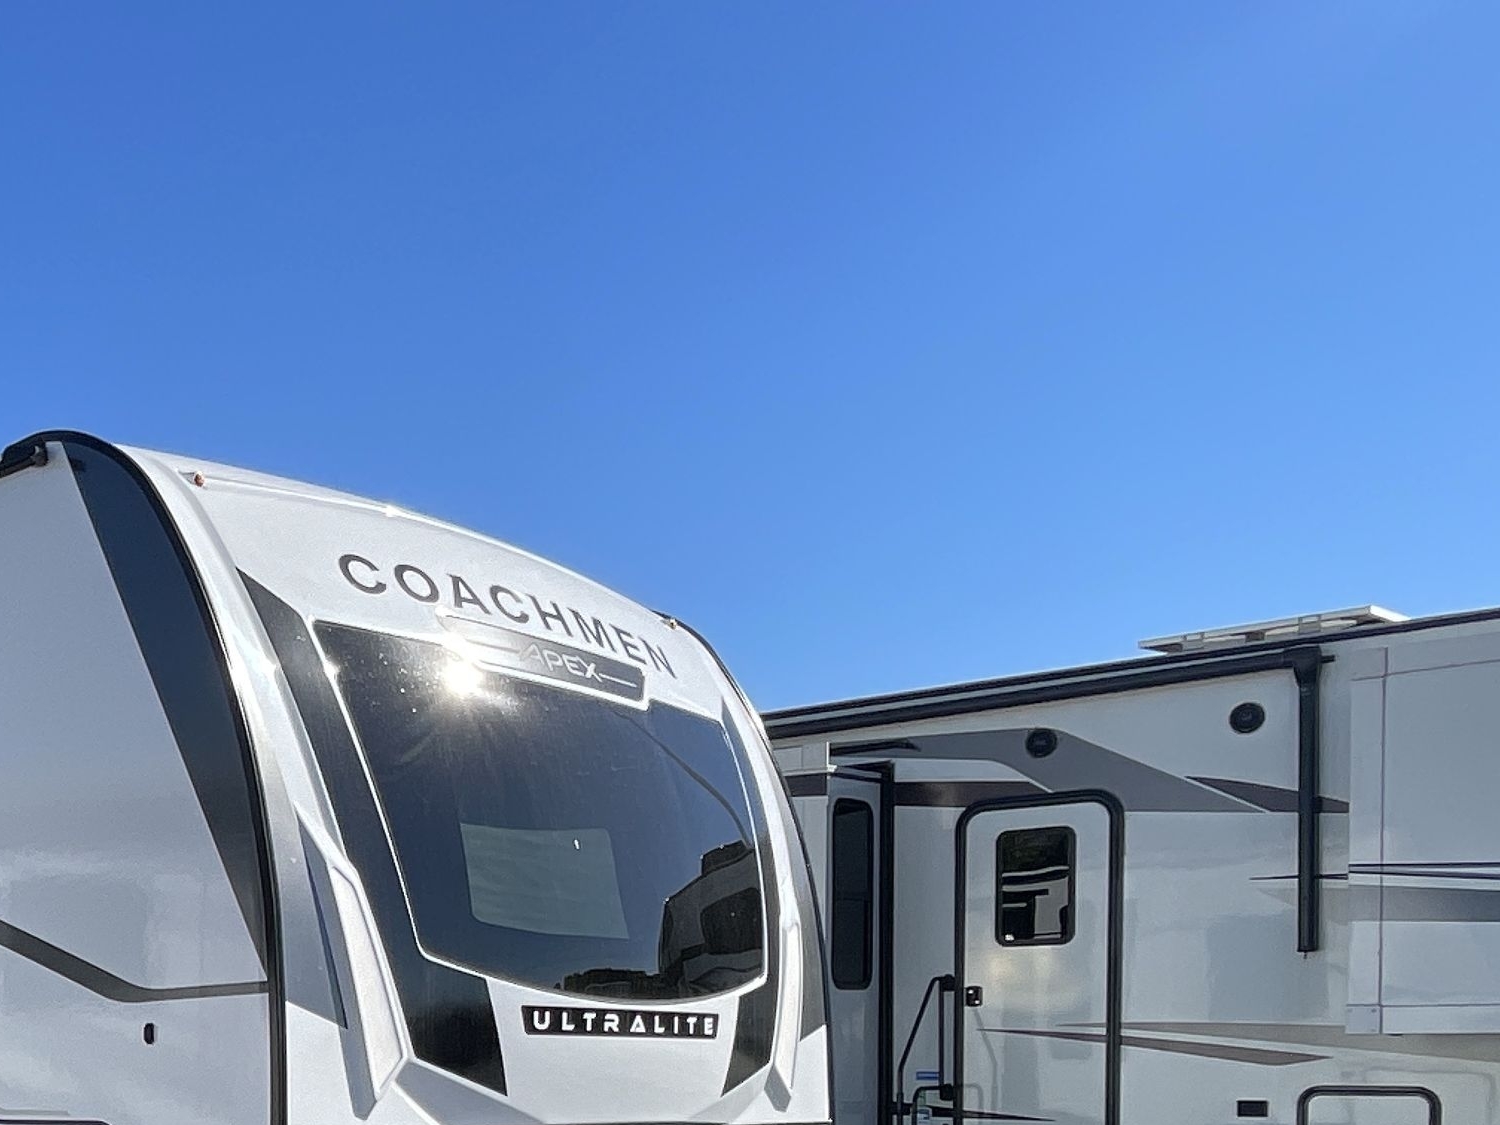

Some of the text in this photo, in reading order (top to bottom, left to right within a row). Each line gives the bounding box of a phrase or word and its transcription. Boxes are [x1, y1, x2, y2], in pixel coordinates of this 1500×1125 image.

[338, 554, 677, 679] COACHMEN
[520, 643, 602, 682] APEX
[532, 1010, 714, 1036] ULTRALITE
